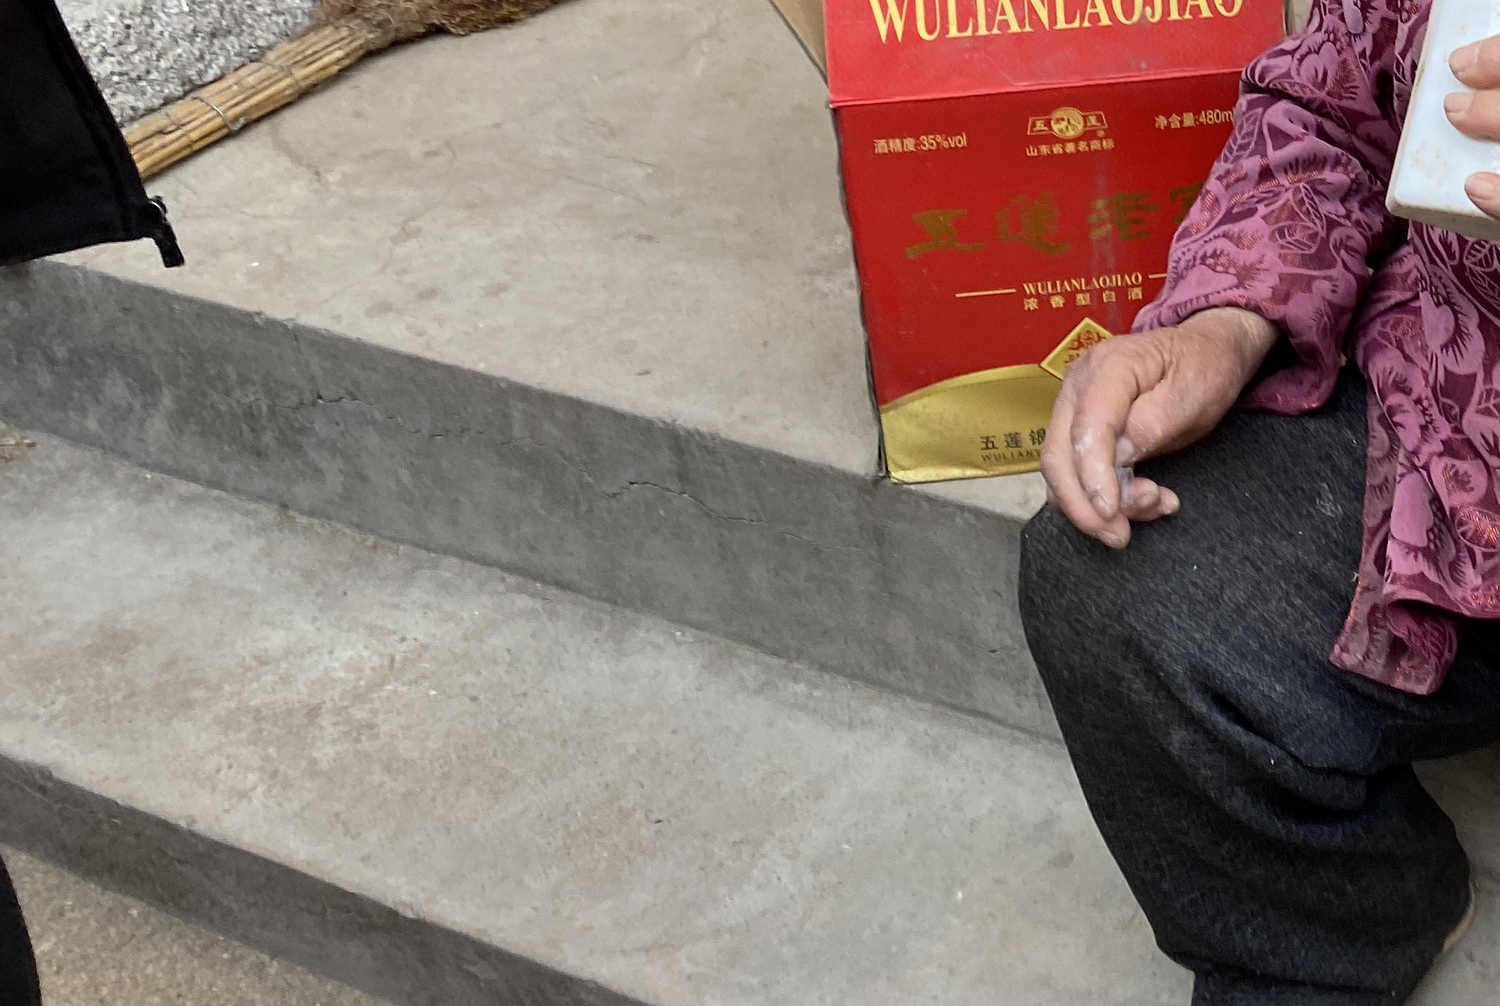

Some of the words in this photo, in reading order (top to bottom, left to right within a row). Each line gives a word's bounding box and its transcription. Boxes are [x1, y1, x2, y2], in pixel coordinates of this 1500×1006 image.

[1154, 107, 1235, 130] 净含量:480m
[1022, 272, 1143, 296] WULIANLAOJIAO
[1023, 287, 1143, 312] 浓香型白酒
